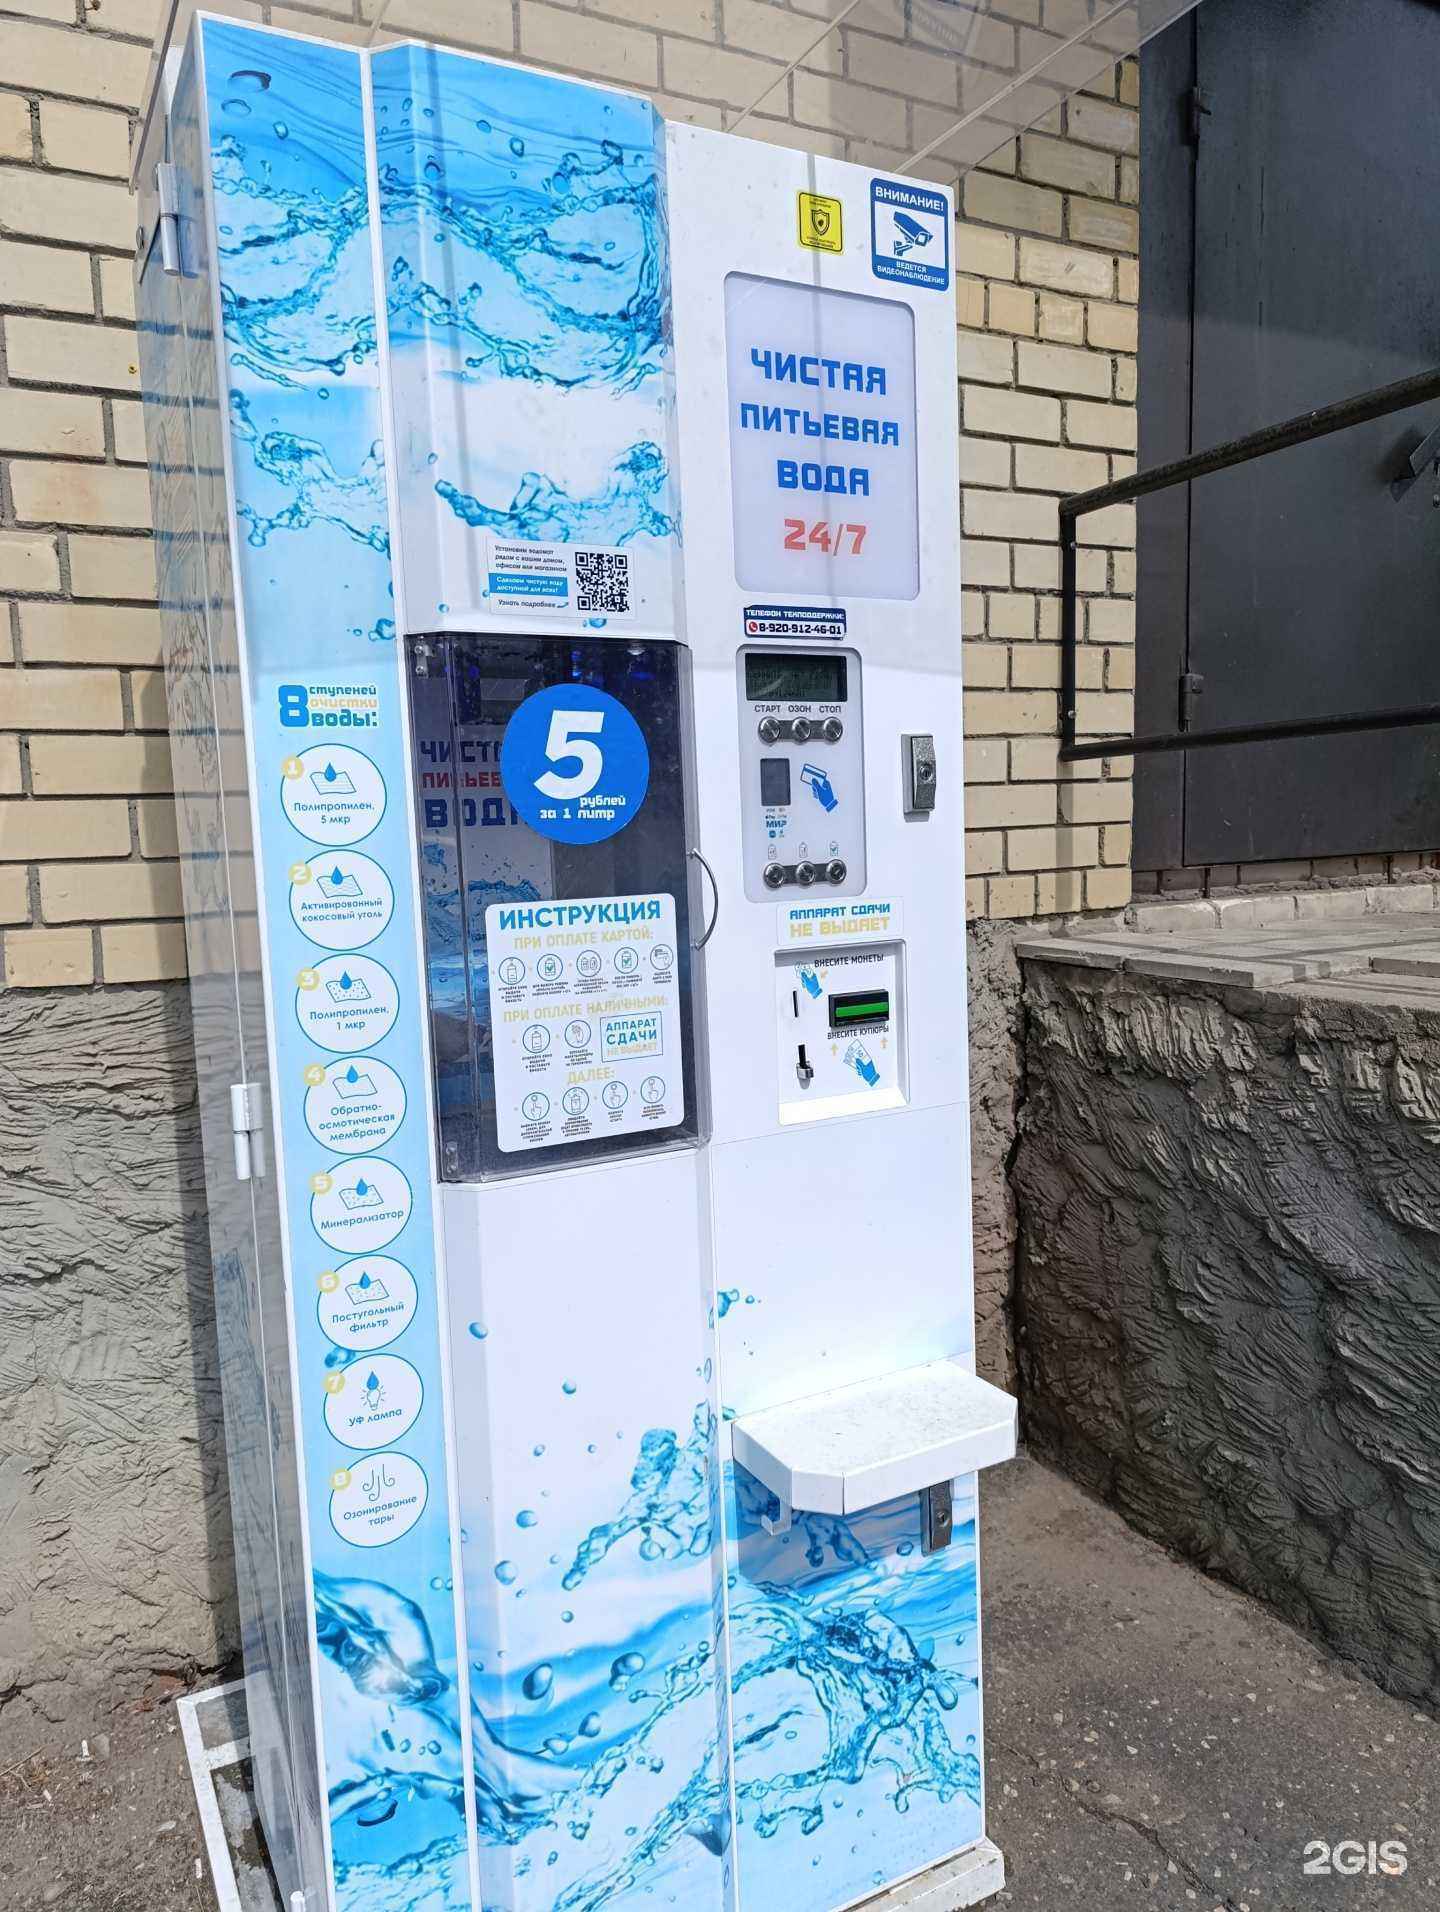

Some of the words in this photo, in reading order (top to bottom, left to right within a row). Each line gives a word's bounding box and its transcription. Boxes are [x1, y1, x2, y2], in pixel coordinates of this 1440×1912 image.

[875, 186, 944, 211] ВНИМАНИЕ!
[877, 265, 945, 285] ВИДЕОНАБЛЮДЕНИЕ
[896, 261, 927, 273] ВЕДЕТСЯ
[751, 347, 887, 396] ЧИСТАЯ
[741, 402, 899, 447] ПИТЬЕВАЯ
[777, 459, 870, 496] ВОДА
[784, 518, 867, 556] 24/7
[746, 609, 781, 617] ТЕЛЕФОН
[759, 623, 842, 635] 8-920-912-46-01
[309, 685, 376, 697] ступеней
[278, 684, 309, 727] 8
[310, 697, 377, 708] очистки
[754, 704, 781, 713] СТАРТ
[788, 705, 811, 713] ОЗОН
[819, 705, 842, 713] СТОП
[312, 709, 378, 727] воды:
[533, 709, 605, 800] 5
[294, 802, 375, 813] Полипропилен,
[580, 794, 626, 808] рублей
[321, 815, 326, 824] 5
[329, 816, 351, 825] мкр
[540, 809, 557, 819] за
[563, 808, 572, 819] 1
[577, 809, 615, 821] литр
[301, 898, 383, 911] Активированный
[789, 906, 846, 920] АППАРАТ
[851, 903, 890, 916] СДАЧИ
[302, 911, 355, 922] кокосовый
[358, 910, 383, 921] уголь
[499, 900, 661, 931] ИНСТРУКЦИЯ
[789, 922, 813, 938] НЕ
[819, 916, 890, 935] ВЫДАЕТ
[513, 936, 542, 951] ПРИ
[546, 931, 597, 947] ОПЛАТЕ
[601, 927, 654, 942] КАРТОЙ:
[814, 956, 849, 968] ВНЕСИТЕ
[851, 954, 884, 964] МОНЕТЫ
[310, 1006, 390, 1021] Полипропилен,
[503, 1008, 529, 1023] ПРИ
[534, 1003, 583, 1020] ОПЛАТЕ
[344, 1020, 366, 1031] мкр
[606, 1018, 657, 1032] АППАРАТ
[827, 1028, 858, 1040] ВНЕСИТЕ
[859, 1025, 890, 1037] КУПЮРЫ
[606, 1029, 658, 1046] СДАЧИ
[567, 1067, 615, 1085] ДАЛЕЕ:
[330, 1104, 383, 1118] Обратно-
[318, 1113, 395, 1131] осмотическая
[329, 1126, 386, 1142] мембрана
[320, 1209, 404, 1230] Минерализатор
[332, 1301, 405, 1324] Постугольный
[350, 1318, 389, 1333] фильтр
[348, 1414, 365, 1427] УФ
[367, 1408, 402, 1424] лампа
[343, 1495, 418, 1521] Озонирование
[368, 1513, 395, 1526] тары
